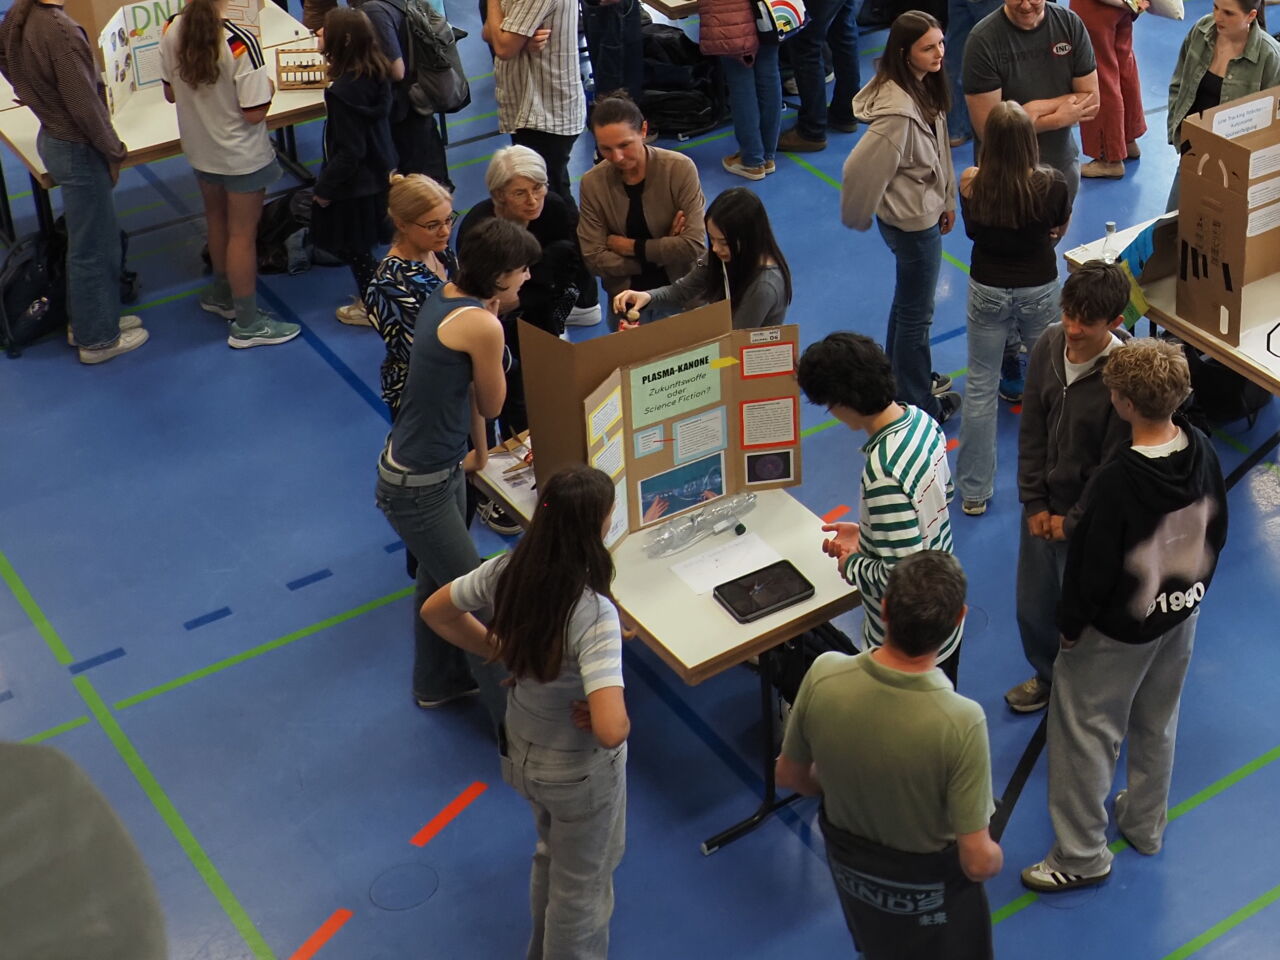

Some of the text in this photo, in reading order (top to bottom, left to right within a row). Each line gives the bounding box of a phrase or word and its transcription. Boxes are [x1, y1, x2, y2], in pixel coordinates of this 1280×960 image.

[641, 355, 710, 385] PLASMA-KANONE
[643, 386, 712, 415] Science Fiction?
[667, 387, 687, 399] oder
